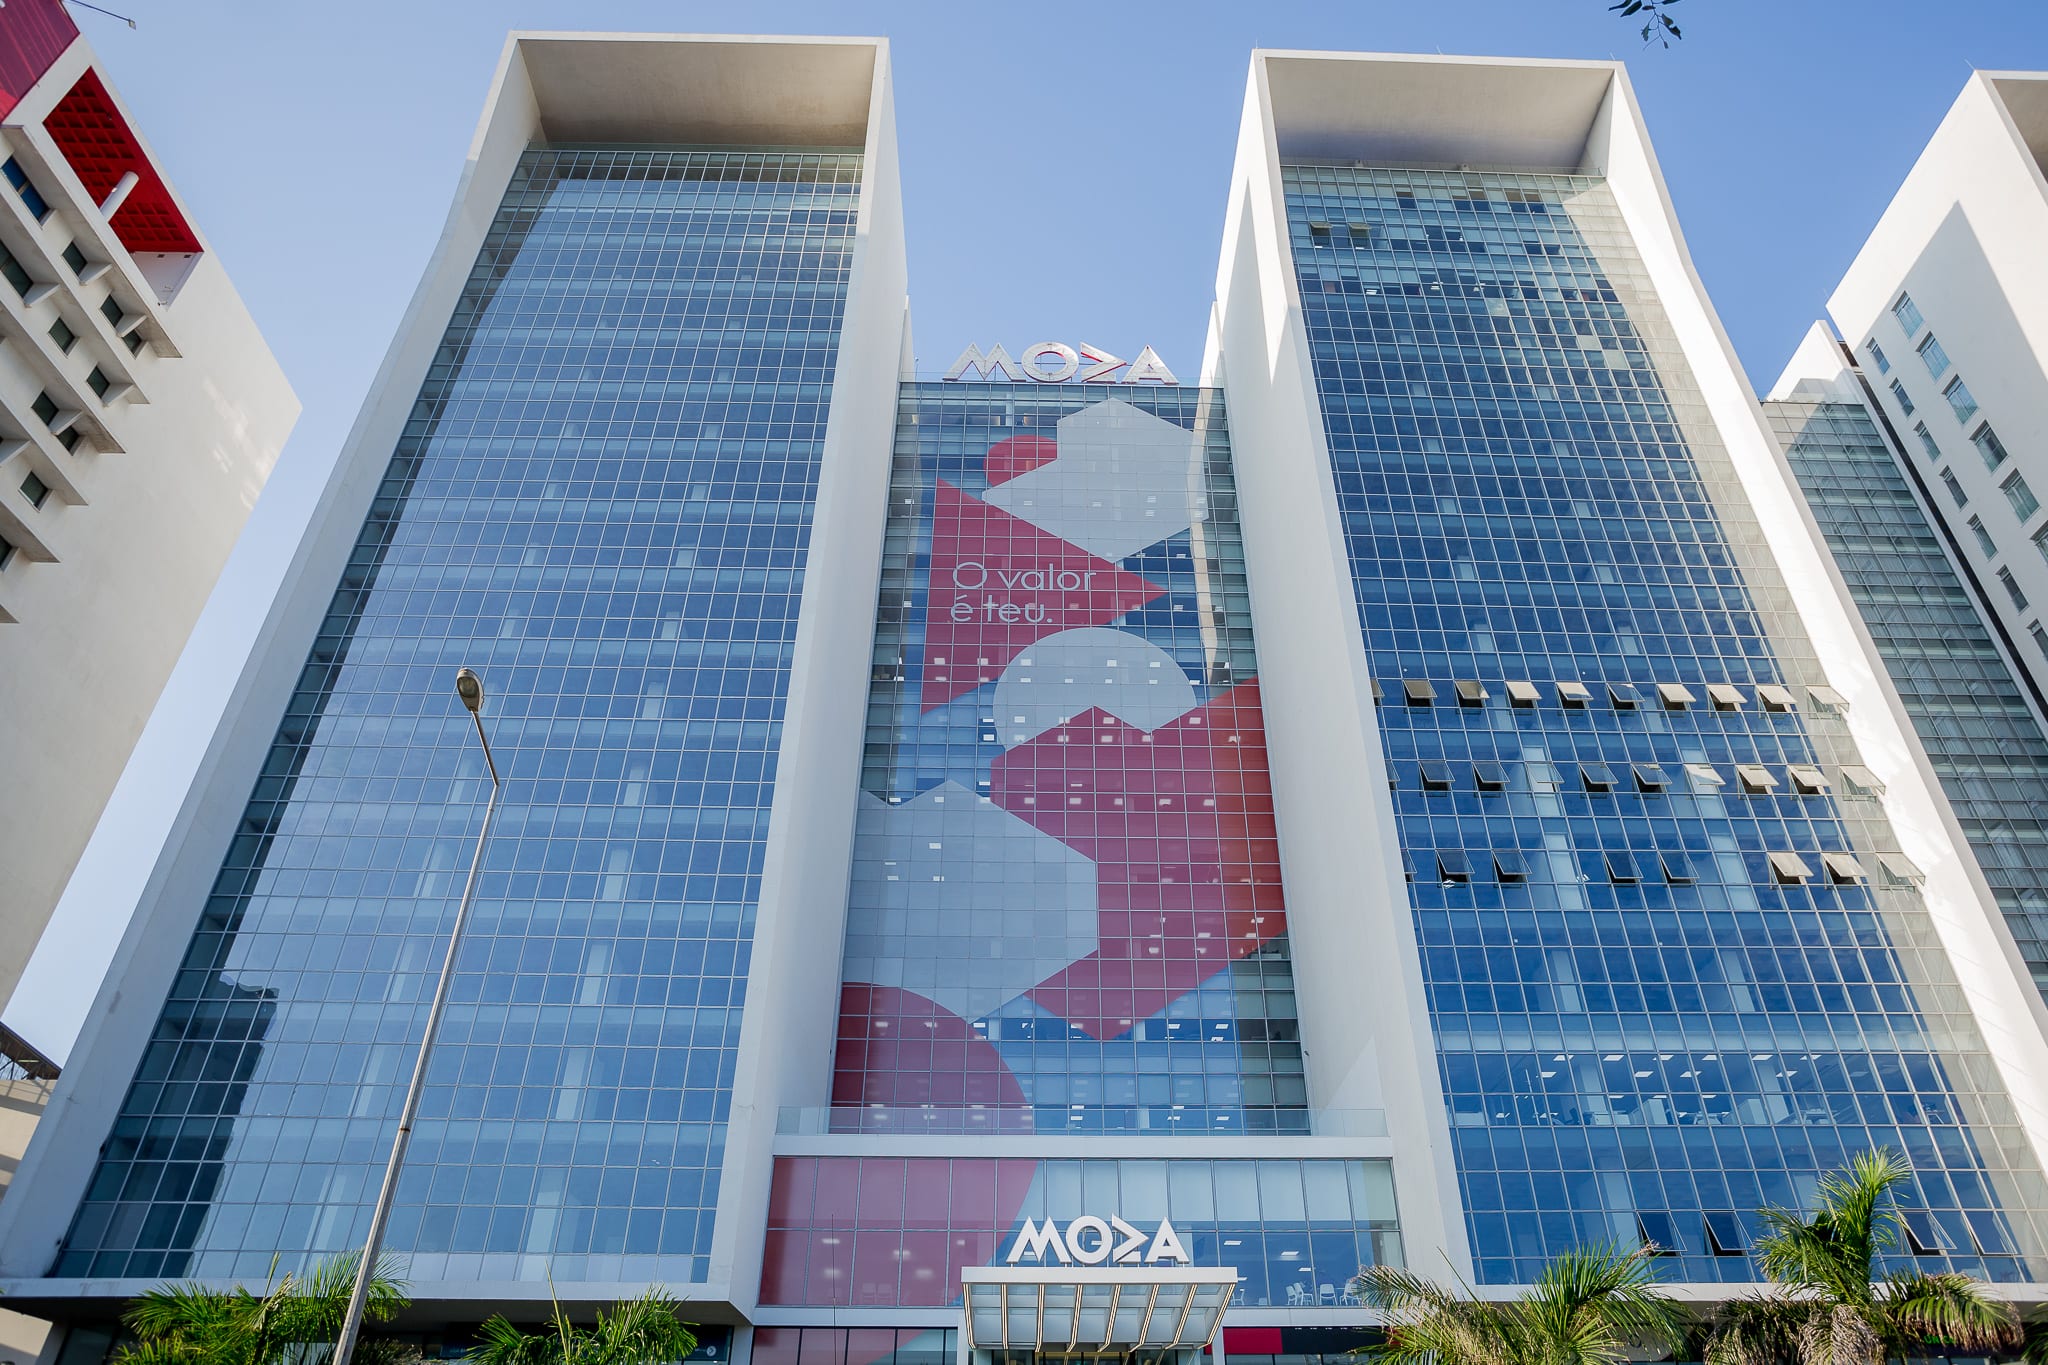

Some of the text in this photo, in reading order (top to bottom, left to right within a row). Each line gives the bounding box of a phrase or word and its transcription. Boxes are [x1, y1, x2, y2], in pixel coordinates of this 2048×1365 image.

[942, 341, 1179, 385] MOZA
[953, 561, 1097, 591] O valor
[951, 594, 1053, 623] é teu.
[1005, 1213, 1190, 1265] MOZA
